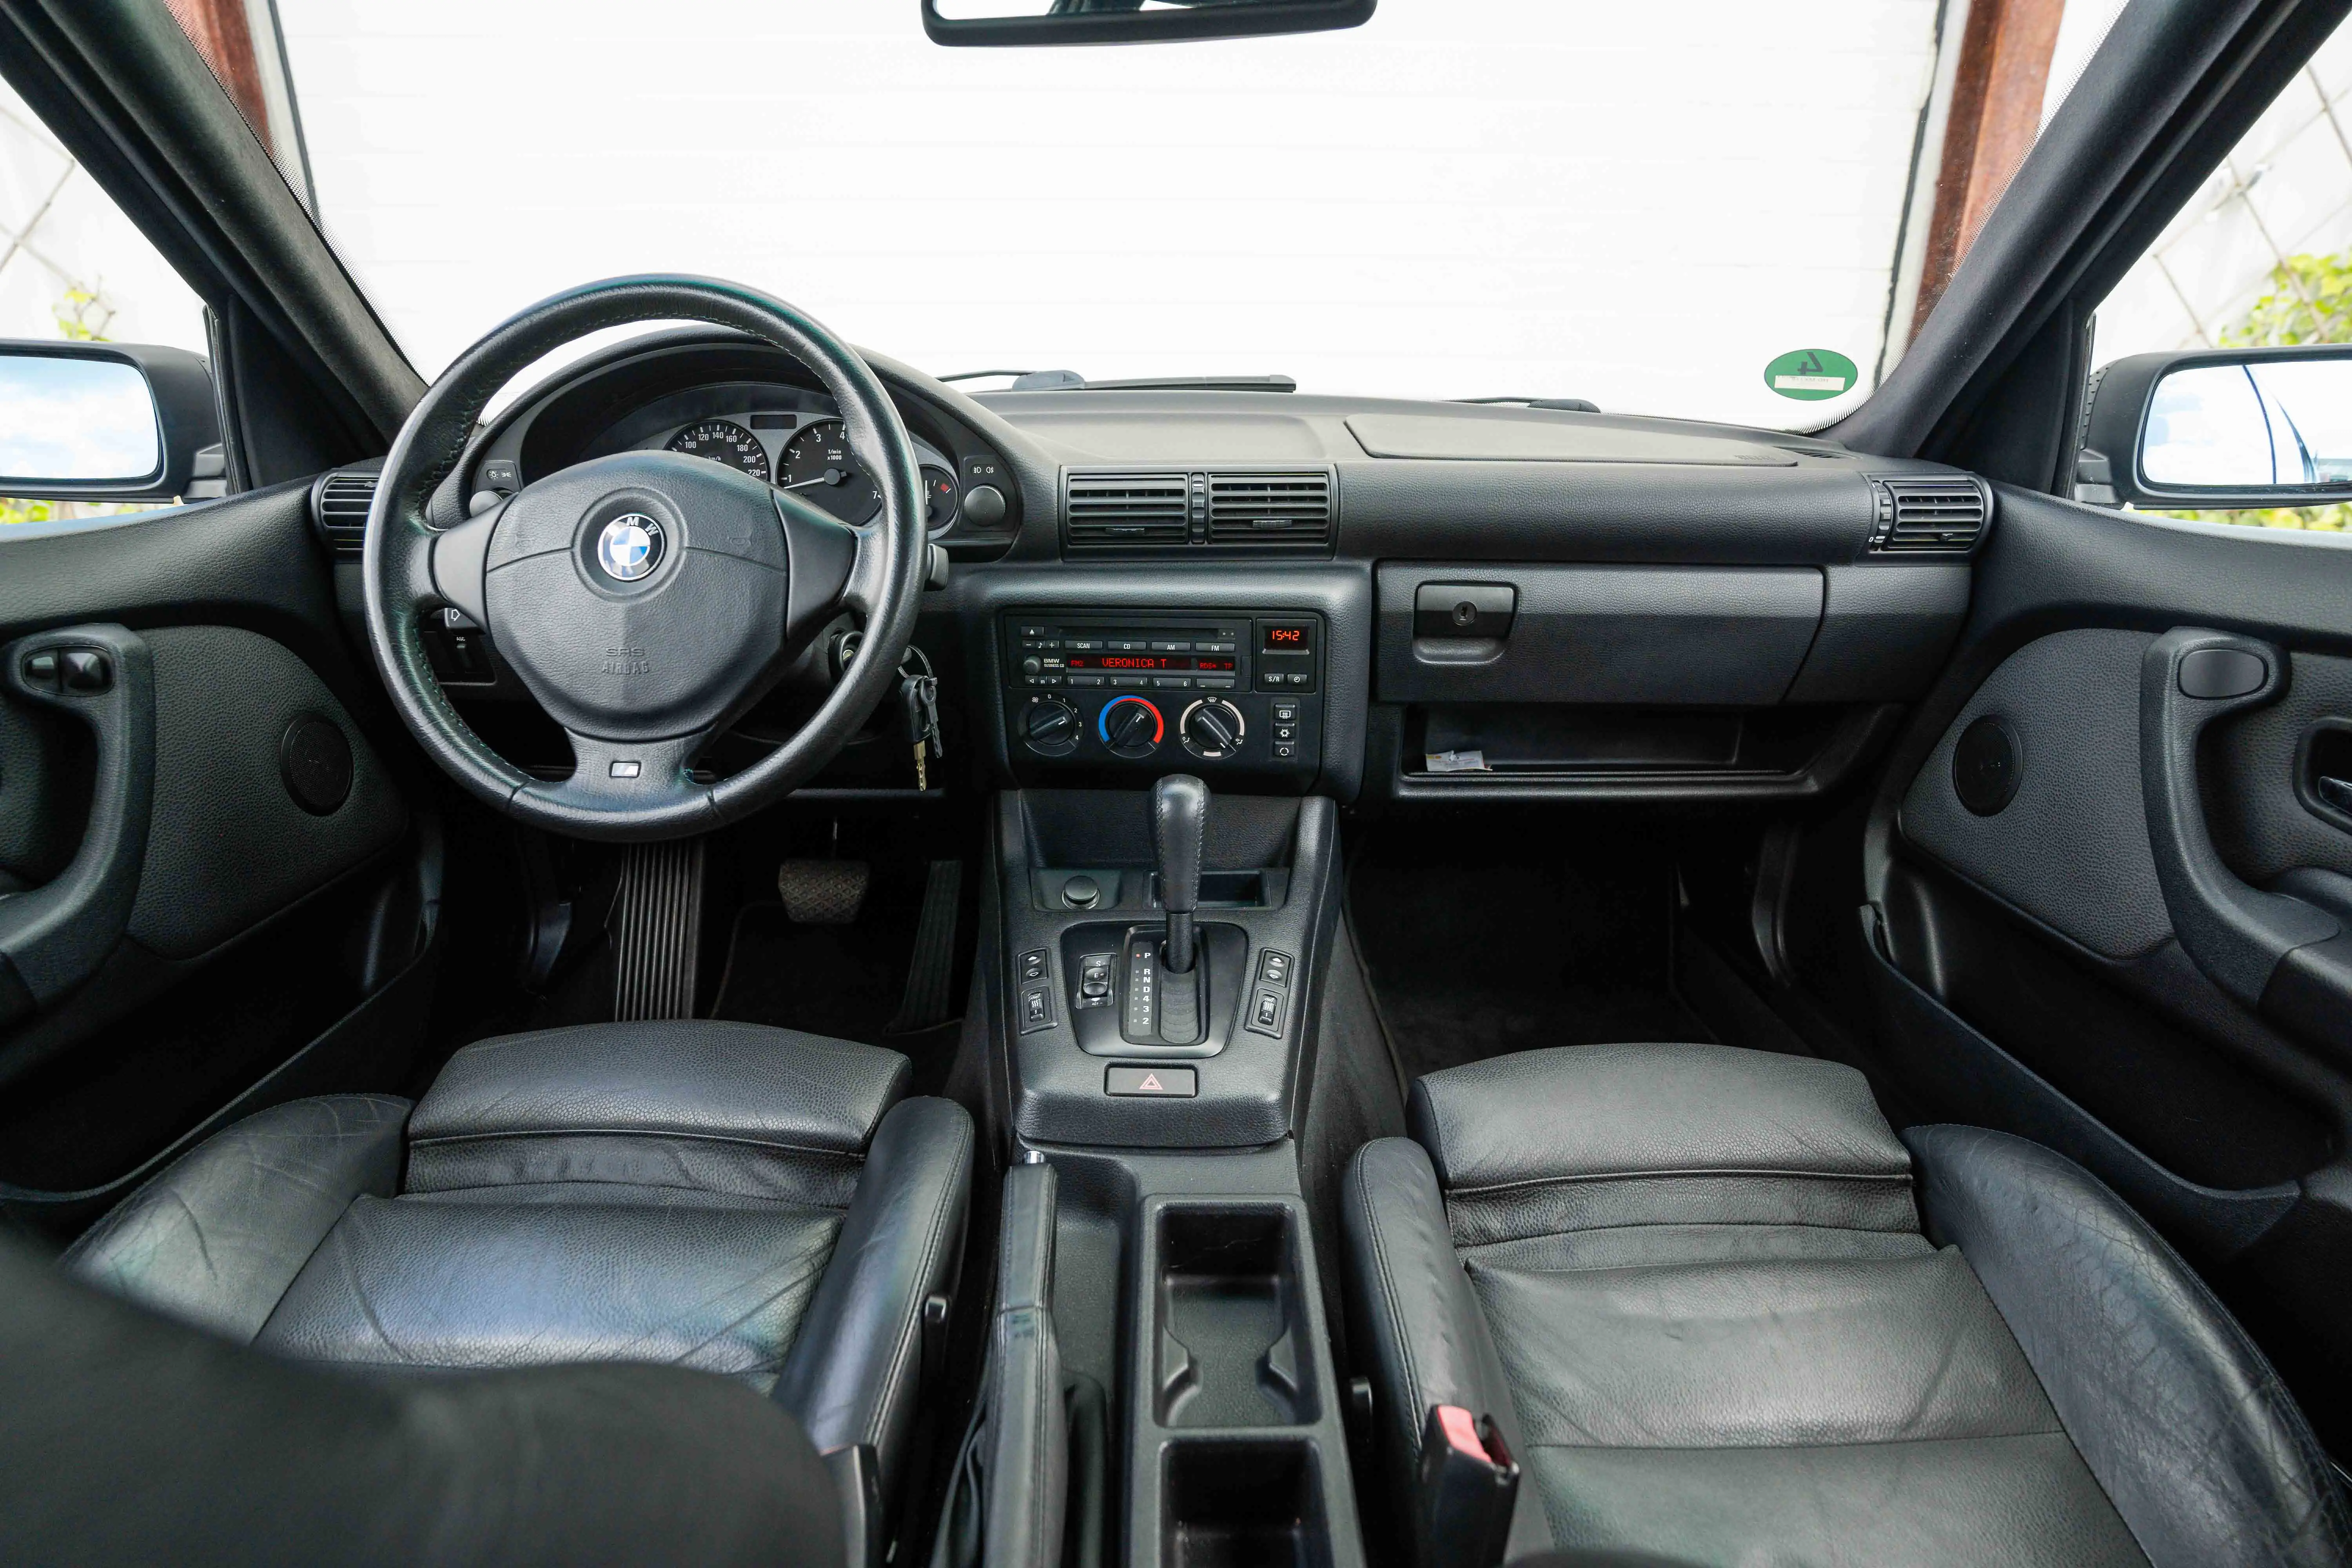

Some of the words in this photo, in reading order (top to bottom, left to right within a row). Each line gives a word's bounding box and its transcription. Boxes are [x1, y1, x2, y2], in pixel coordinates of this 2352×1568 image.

[1272, 630, 1299, 641] 15:42
[1102, 658, 1154, 668] VERONICA
[1160, 659, 1167, 668] T
